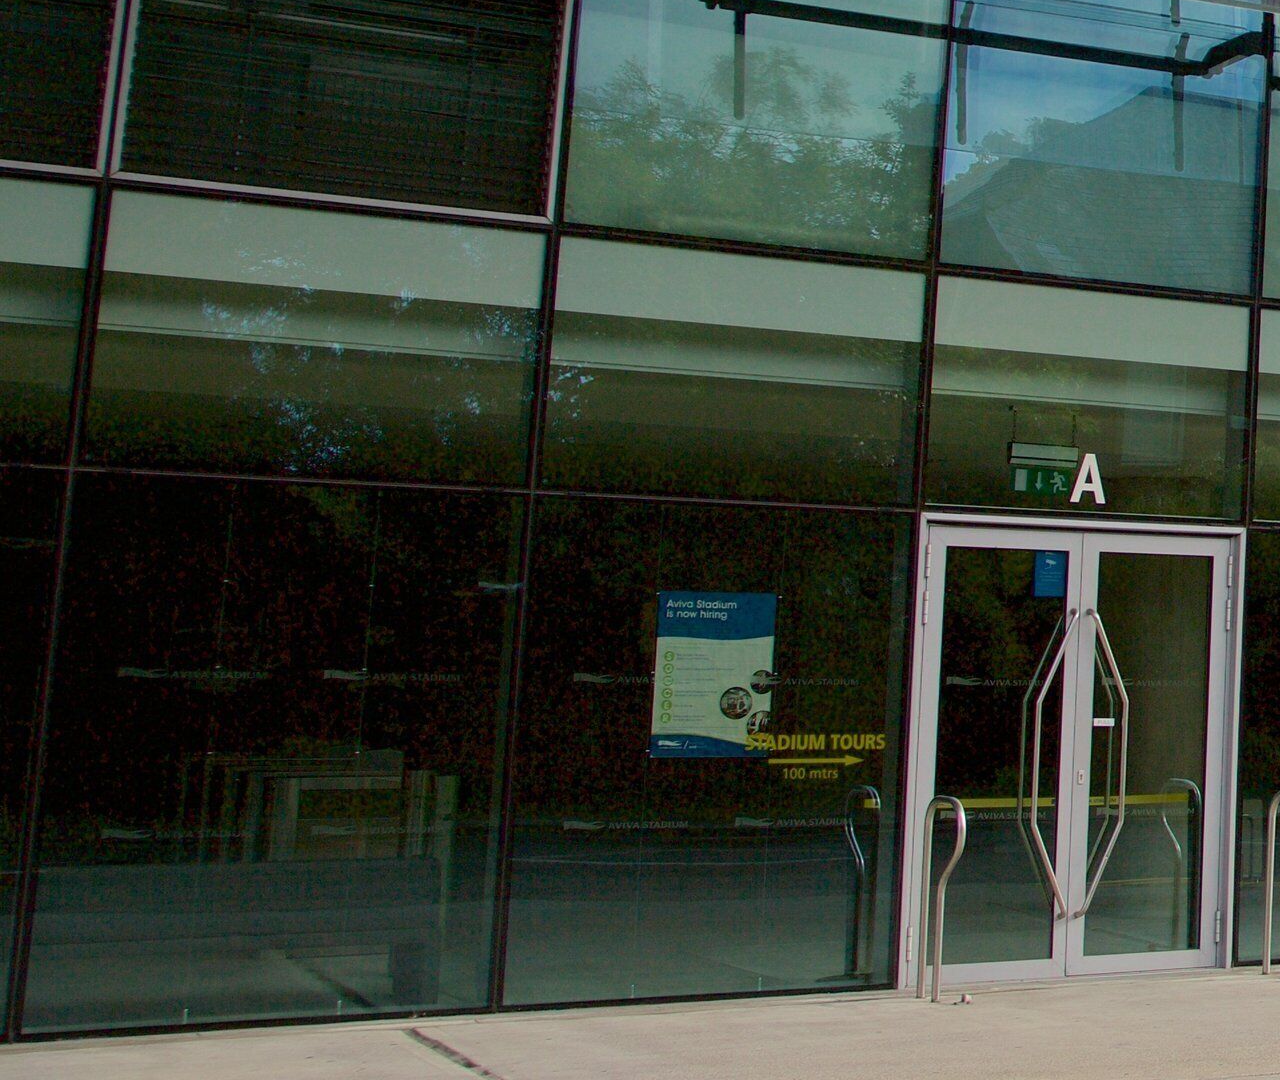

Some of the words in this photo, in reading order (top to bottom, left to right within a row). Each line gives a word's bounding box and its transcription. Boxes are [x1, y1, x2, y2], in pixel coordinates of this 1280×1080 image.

[1069, 453, 1107, 504] A
[666, 600, 693, 608] Aviva
[696, 600, 737, 609] Stadium
[666, 609, 673, 618] is
[677, 610, 697, 618] now
[700, 610, 728, 621] hiring
[744, 733, 826, 750] STADIUM
[830, 733, 887, 751] TOURS
[784, 769, 806, 780] 100
[809, 769, 839, 779] mtrs
